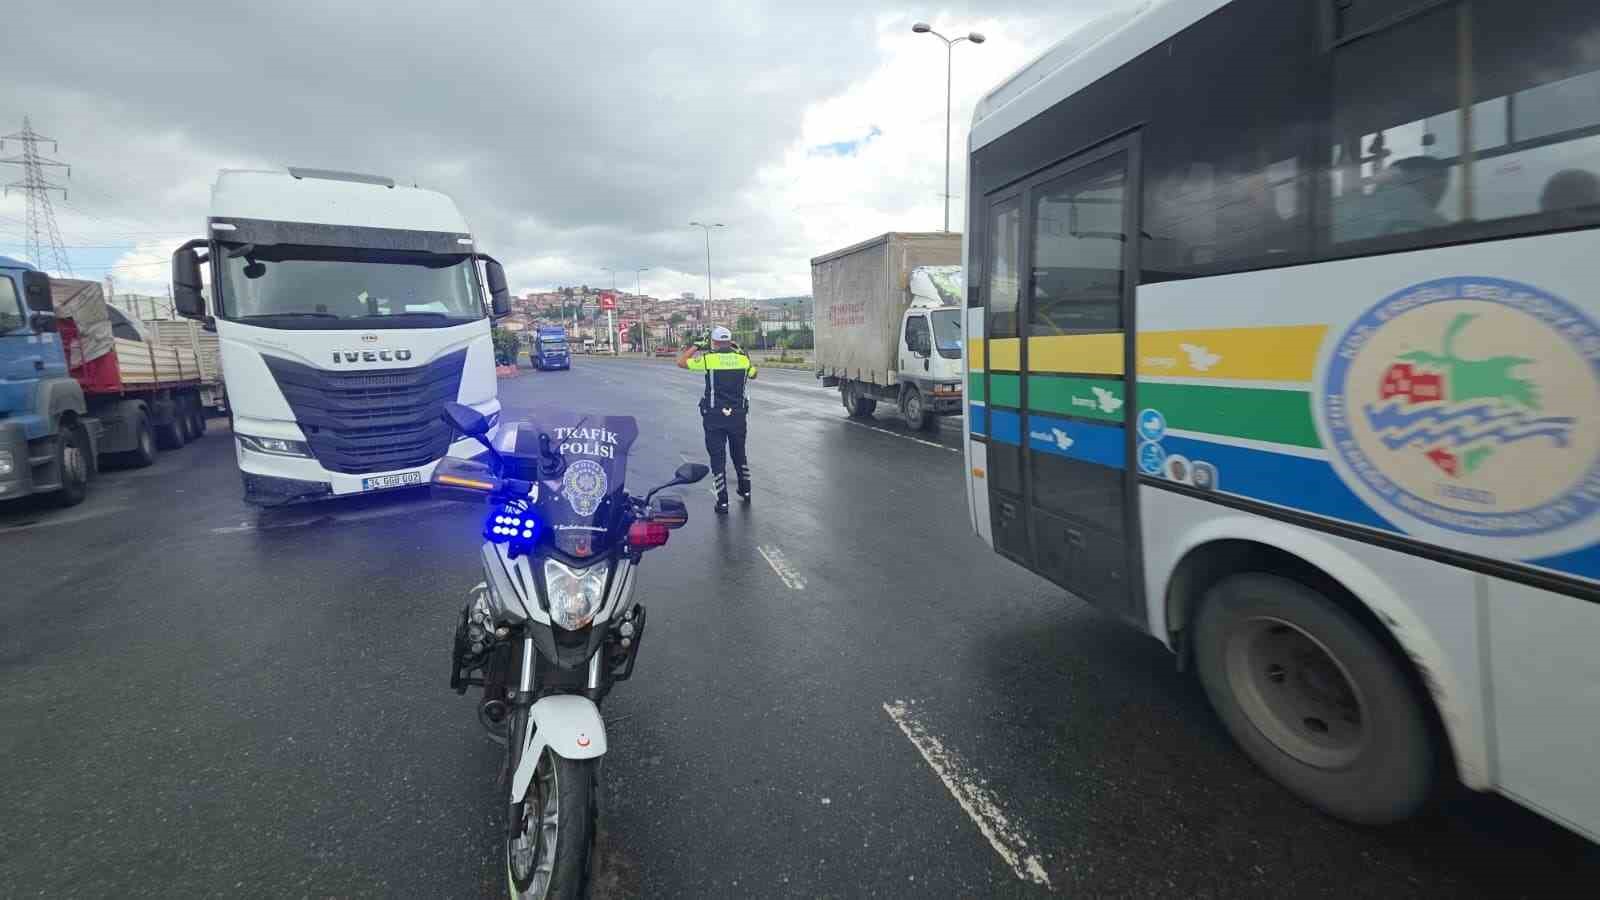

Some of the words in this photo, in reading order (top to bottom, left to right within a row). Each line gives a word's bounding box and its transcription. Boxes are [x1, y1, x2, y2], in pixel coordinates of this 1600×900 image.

[332, 349, 412, 363] IVECO
[553, 427, 618, 445] TRAFİK
[368, 479, 380, 487] 34
